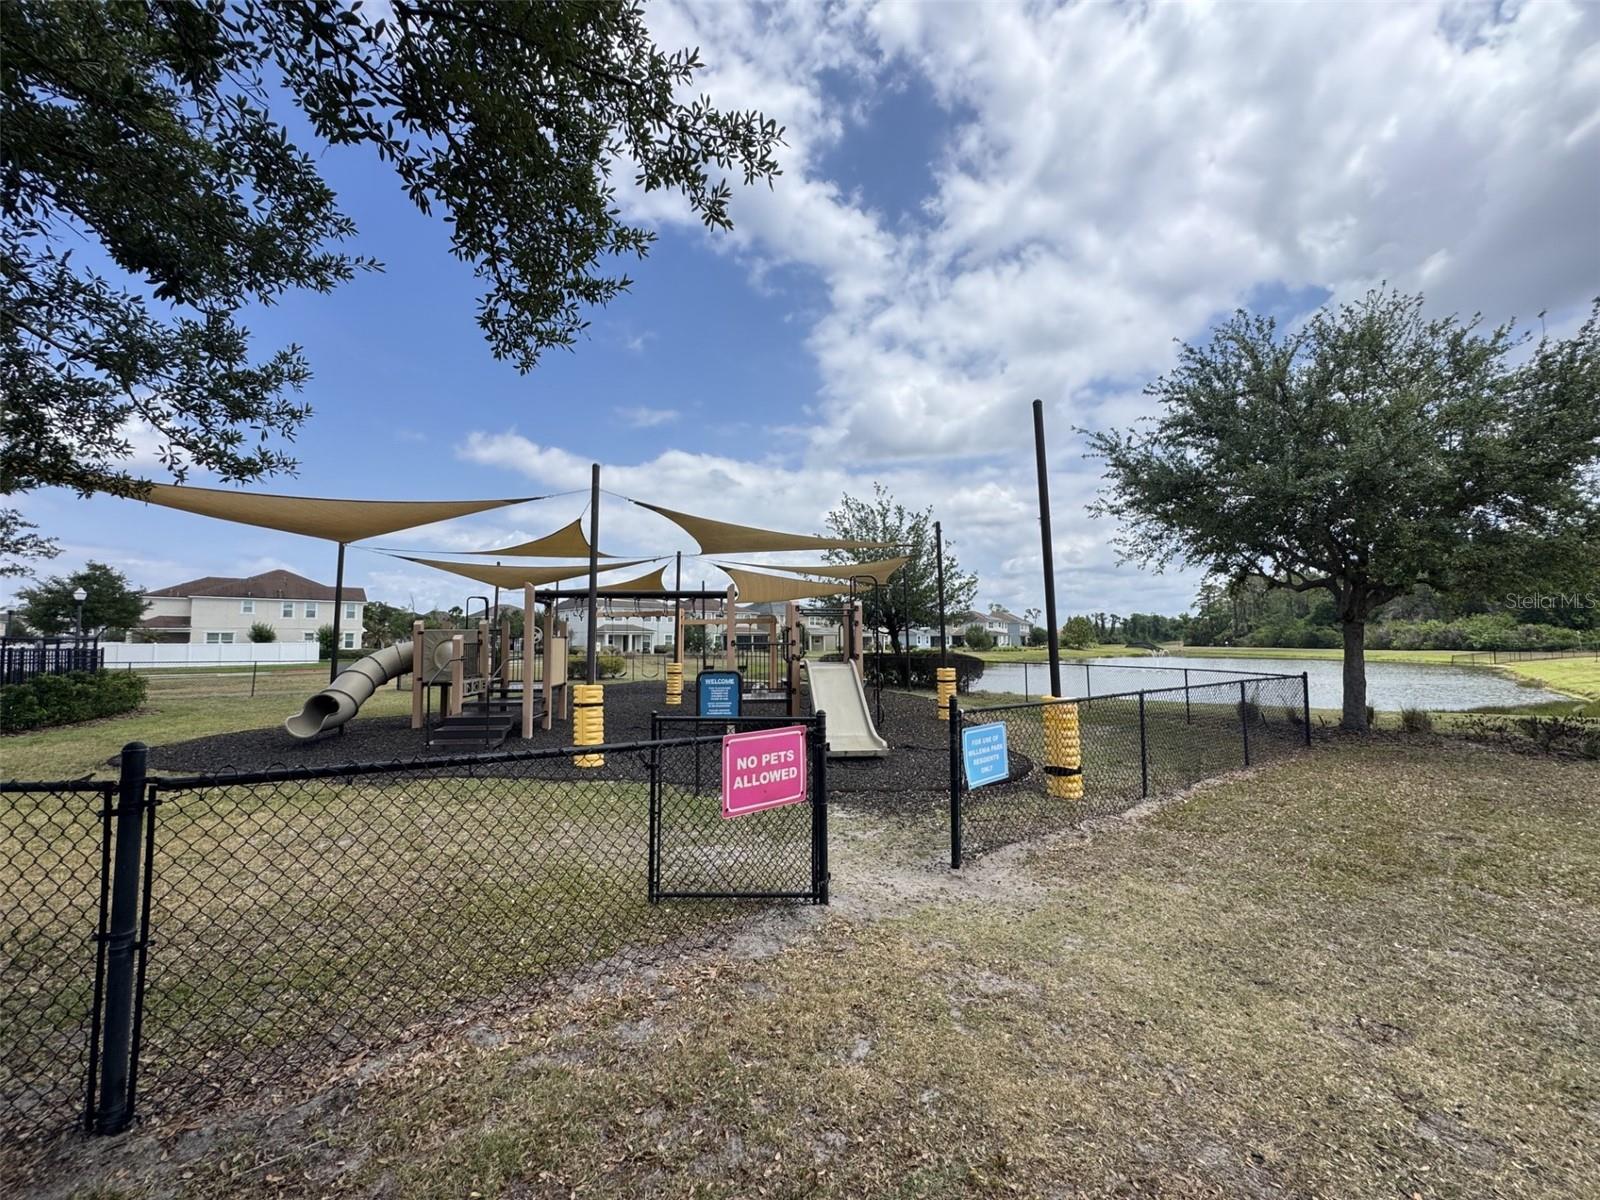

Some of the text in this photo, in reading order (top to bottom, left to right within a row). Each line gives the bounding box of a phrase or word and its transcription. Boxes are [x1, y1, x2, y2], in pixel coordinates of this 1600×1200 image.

[736, 749, 795, 770] NO PETS
[733, 766, 798, 790] ALLOWED
